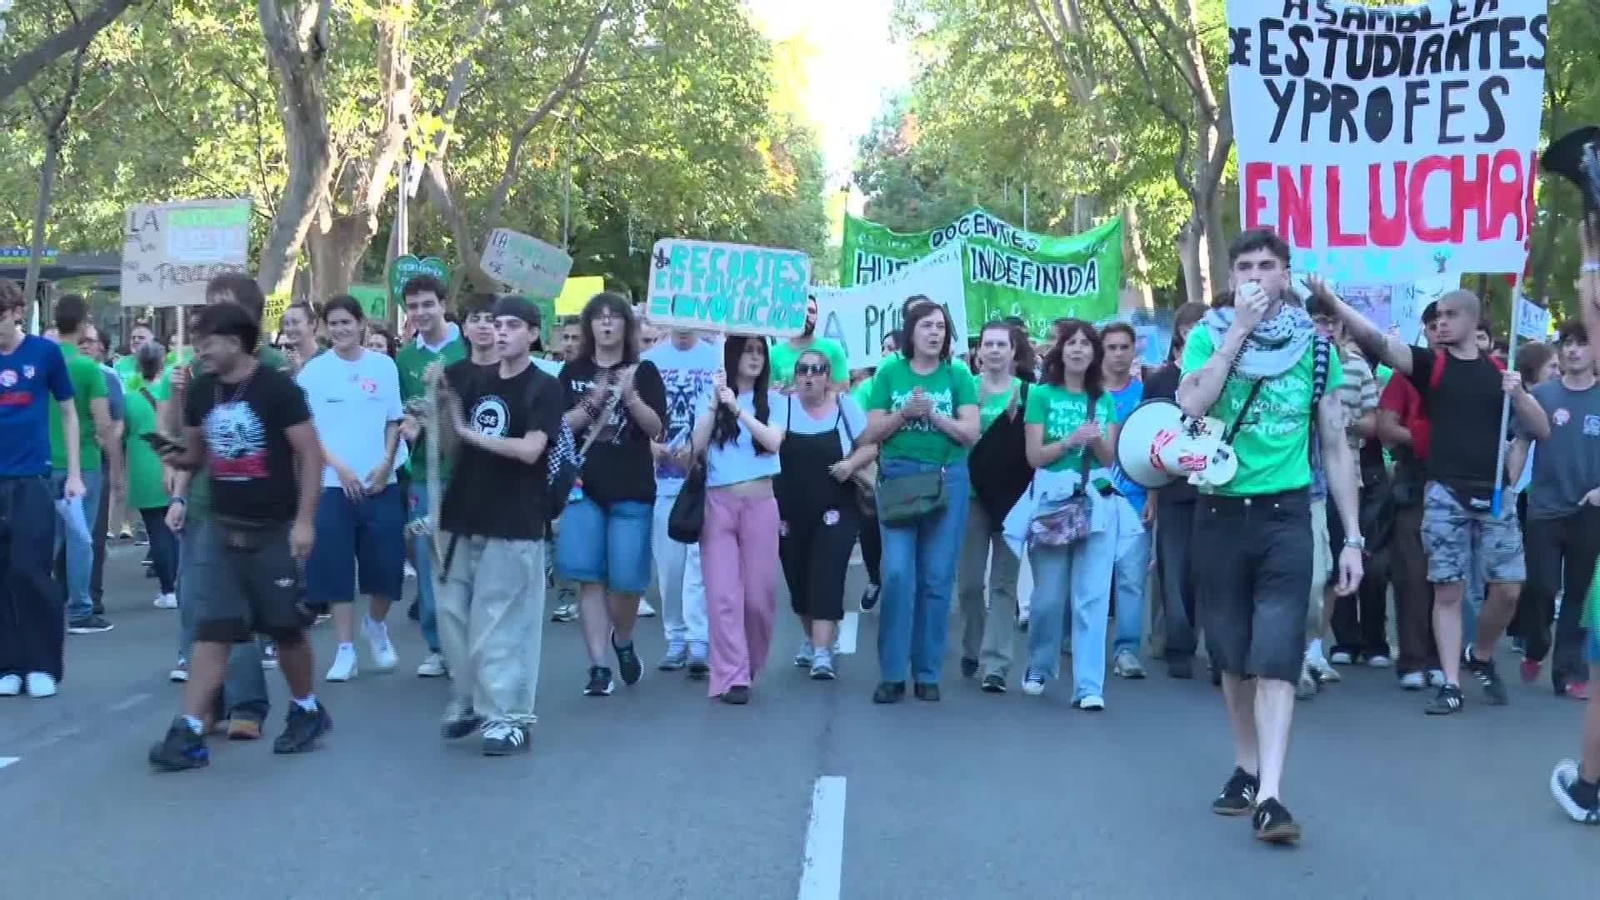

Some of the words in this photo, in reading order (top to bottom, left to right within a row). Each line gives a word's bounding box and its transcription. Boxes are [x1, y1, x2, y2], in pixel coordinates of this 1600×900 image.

[1283, 0, 1499, 33] ASAMBLEA
[1258, 13, 1548, 81] ESTUDIANTES
[1262, 78, 1298, 144] Y
[1300, 75, 1511, 145] PROFES
[130, 210, 160, 233] LA
[1245, 161, 1313, 249] EN
[932, 213, 1040, 251] DOCENTES
[671, 245, 808, 287] RECORTES
[970, 246, 1098, 297] INDEFINIDA
[479, 413, 497, 427] CSE
